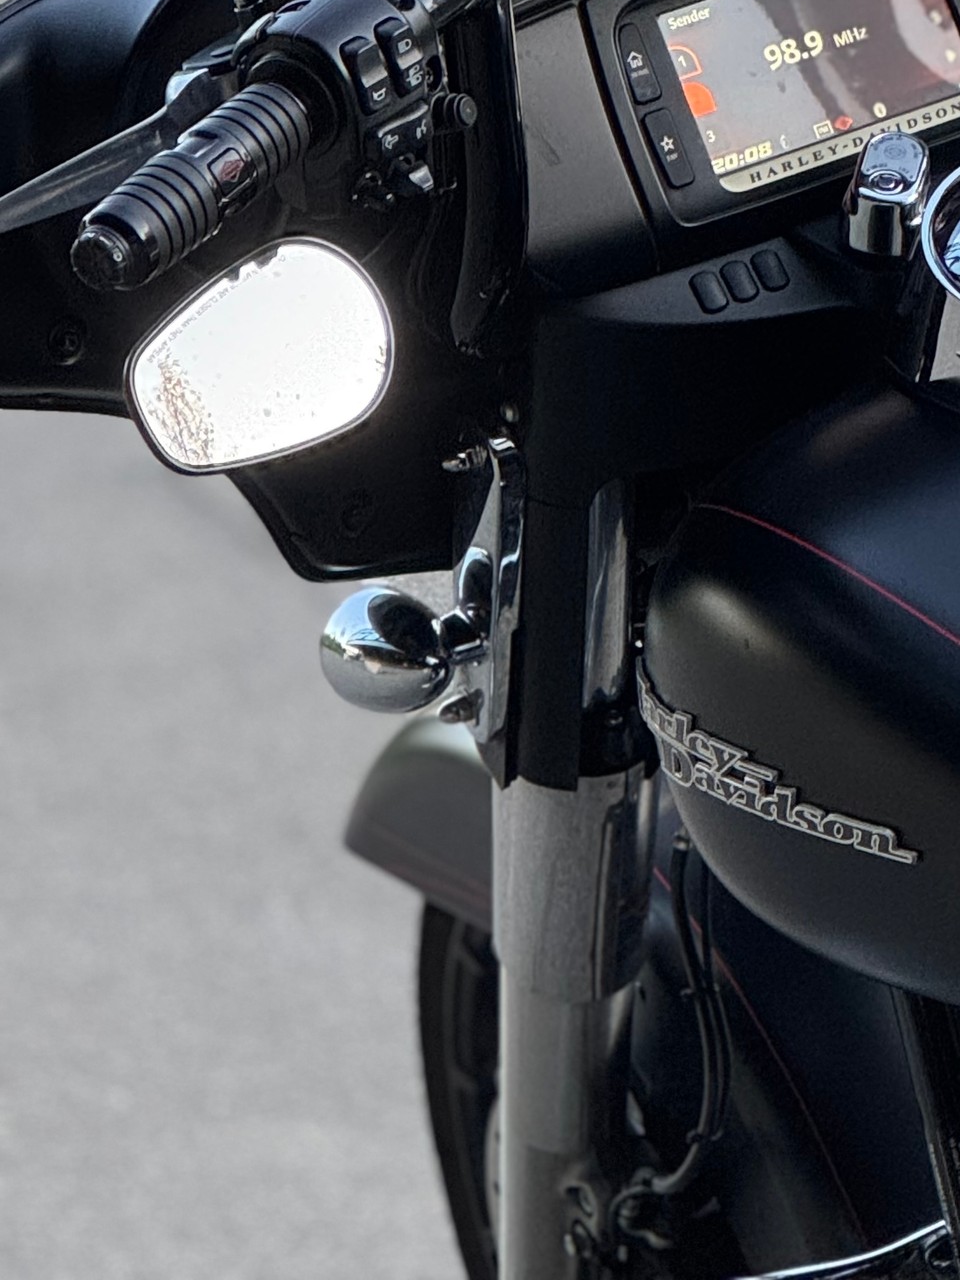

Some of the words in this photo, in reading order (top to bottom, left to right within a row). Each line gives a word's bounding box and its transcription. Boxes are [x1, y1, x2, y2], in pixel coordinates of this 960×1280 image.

[667, 8, 710, 30] Sender
[763, 30, 823, 71] 98.9
[832, 27, 868, 48] MHz
[677, 55, 687, 67] 1
[706, 130, 716, 143] 3
[711, 140, 773, 175] 20:08
[195, 295, 218, 317] CLOSER
[659, 732, 918, 865] Davidson
